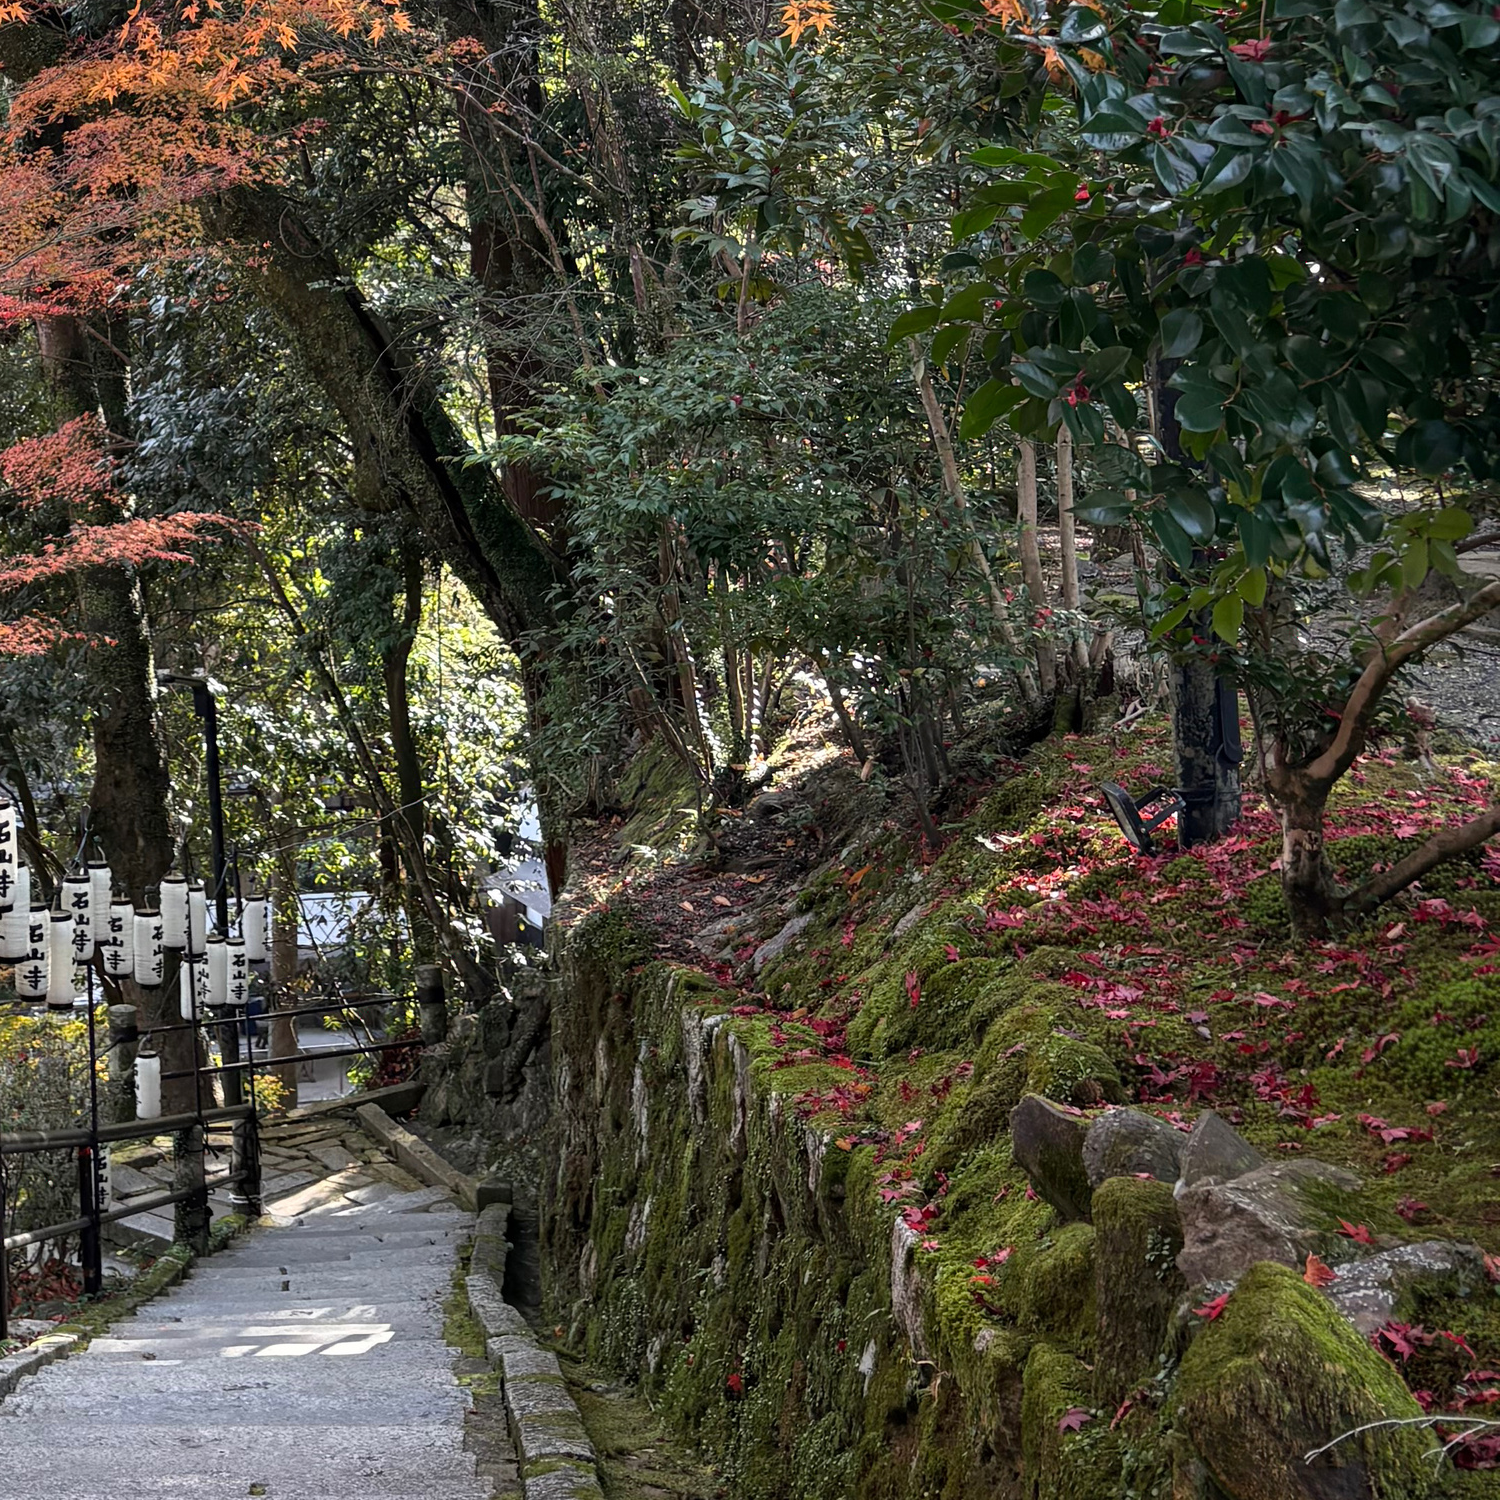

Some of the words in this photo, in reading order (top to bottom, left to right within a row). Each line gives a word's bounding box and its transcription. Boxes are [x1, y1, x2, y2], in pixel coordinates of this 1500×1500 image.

[23, 924, 47, 990] 石山寺
[107, 917, 125, 971] 石山寺
[231, 953, 247, 1000] 石山寺
